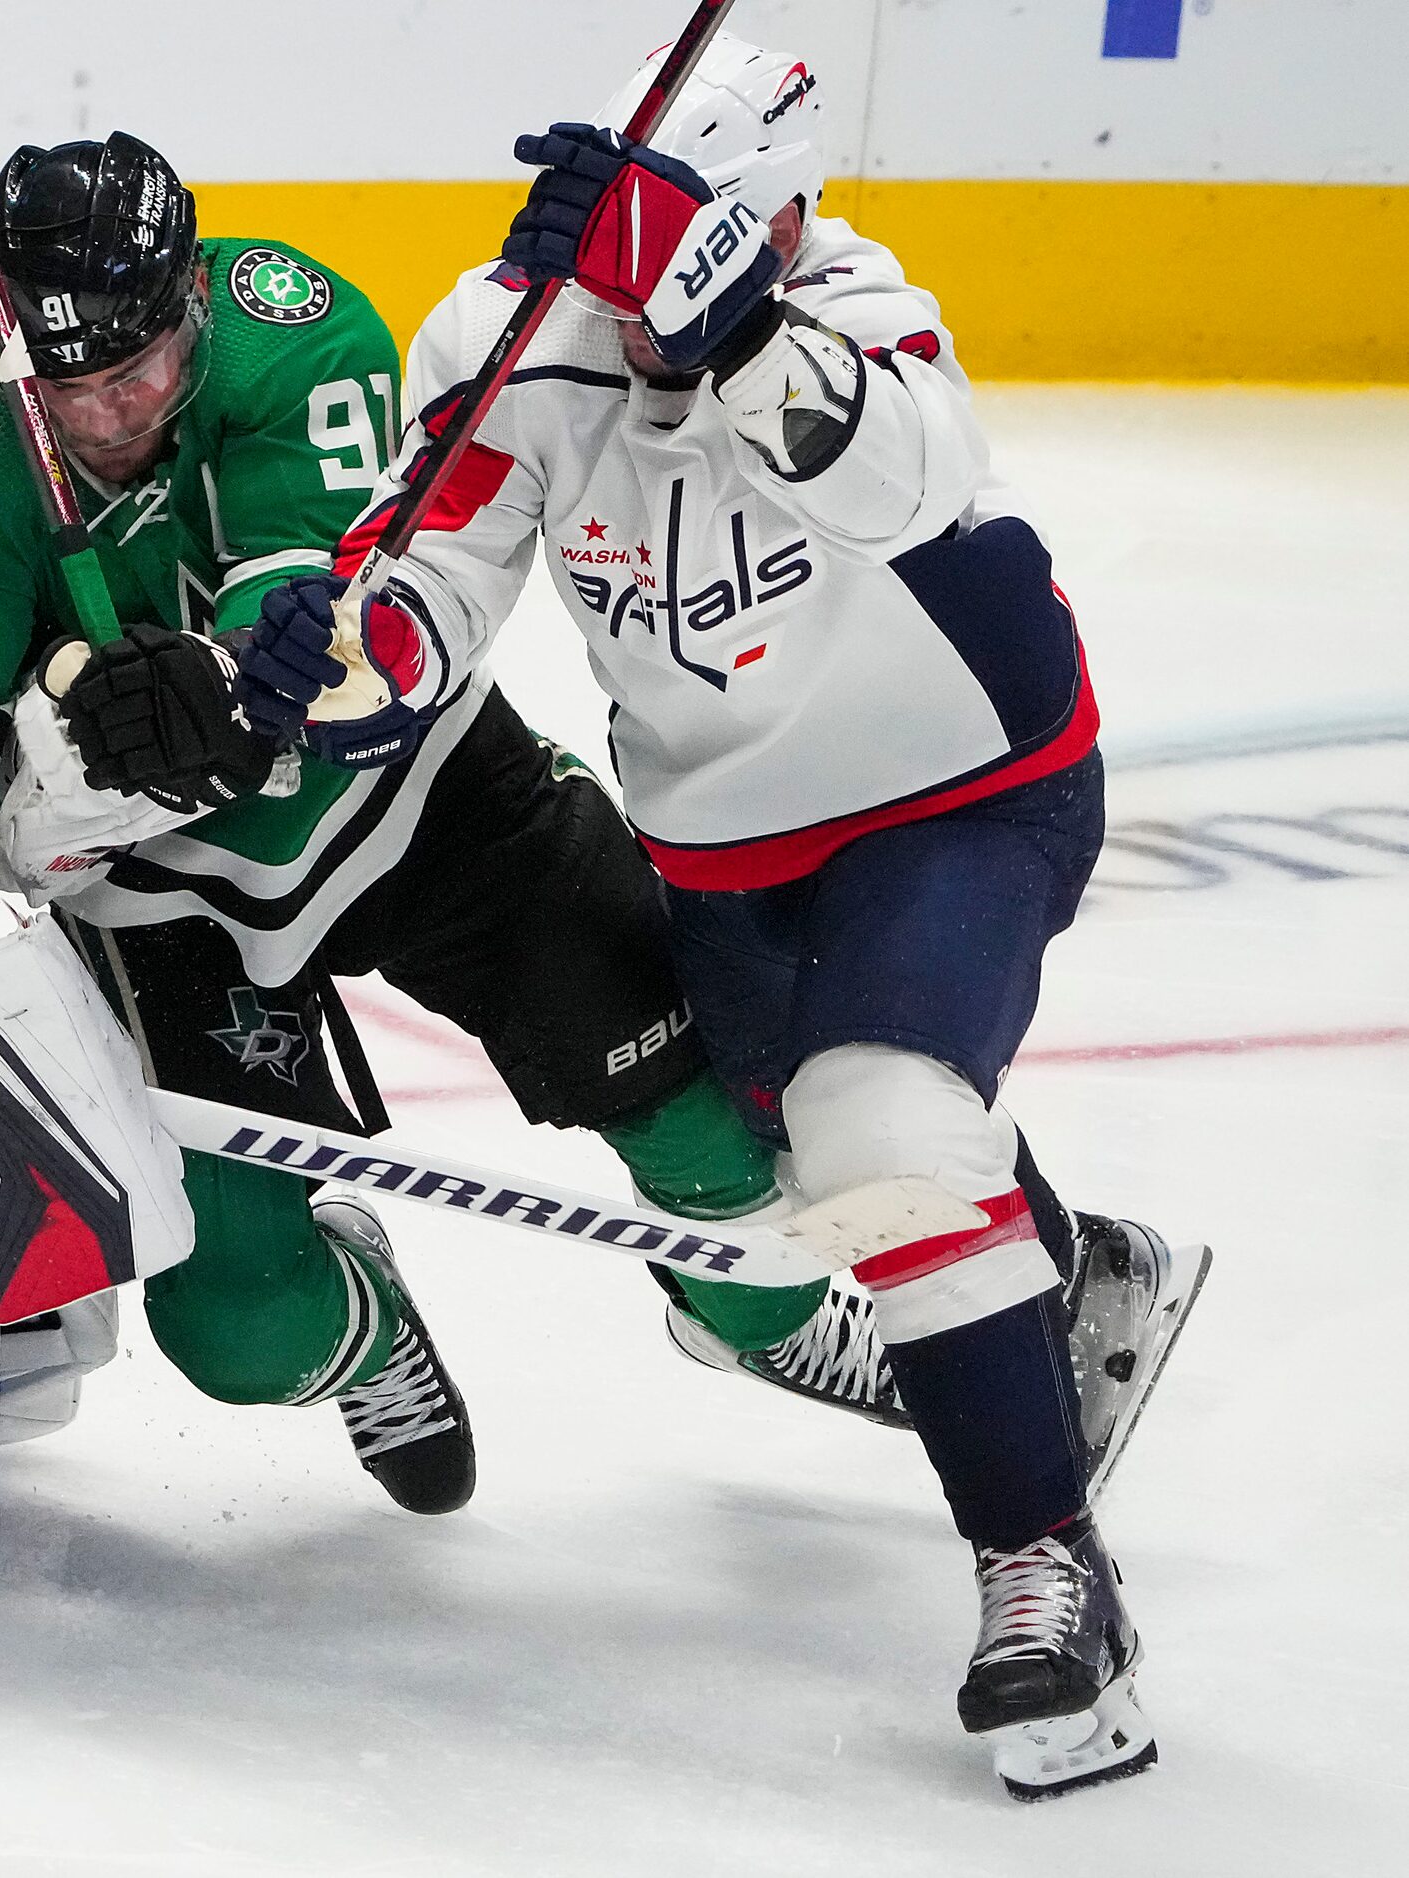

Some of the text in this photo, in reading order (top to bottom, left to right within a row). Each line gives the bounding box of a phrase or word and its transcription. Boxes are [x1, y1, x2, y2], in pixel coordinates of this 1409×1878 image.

[137, 170, 157, 221] ENERGY
[149, 169, 167, 227] TRANSFER
[41, 292, 81, 332] 91
[272, 281, 326, 319] STARS
[307, 373, 397, 491] 91
[344, 738, 402, 762] BAUER
[208, 774, 238, 801] SEGUIN
[220, 1127, 747, 1275] WARRIOR
